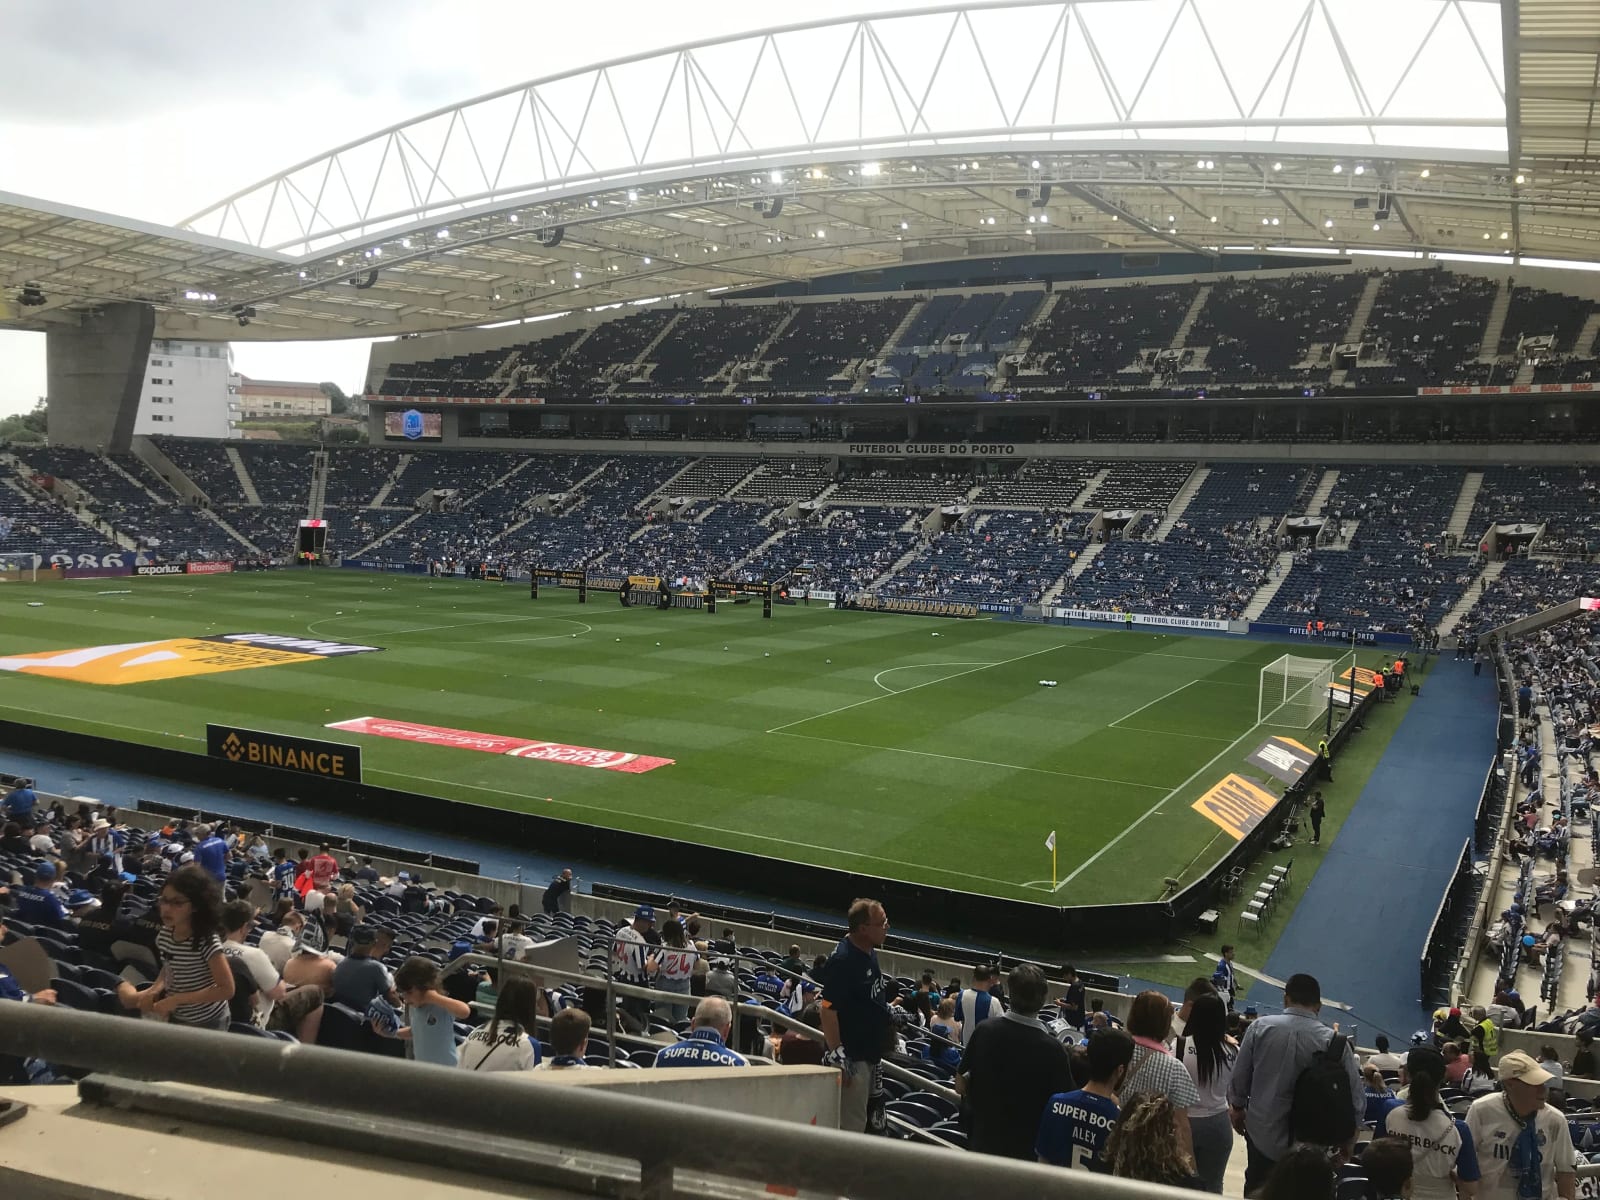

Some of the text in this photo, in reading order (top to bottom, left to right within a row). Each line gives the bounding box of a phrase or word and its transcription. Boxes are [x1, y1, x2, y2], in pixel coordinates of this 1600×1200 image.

[850, 444, 1015, 454] FUTEBOL CLUBE DO PORTO
[1143, 616, 1169, 624] FUTEBOL
[1170, 618, 1189, 626] CLUBE
[1289, 627, 1318, 636] FUTEL
[248, 741, 345, 776] BINANCE
[666, 953, 691, 975] 24
[663, 1047, 737, 1066] SUPER BOCK
[1052, 1101, 1117, 1132] SUPER BOC
[1072, 1126, 1097, 1145] ALEX
[1423, 1138, 1457, 1156] BOCK
